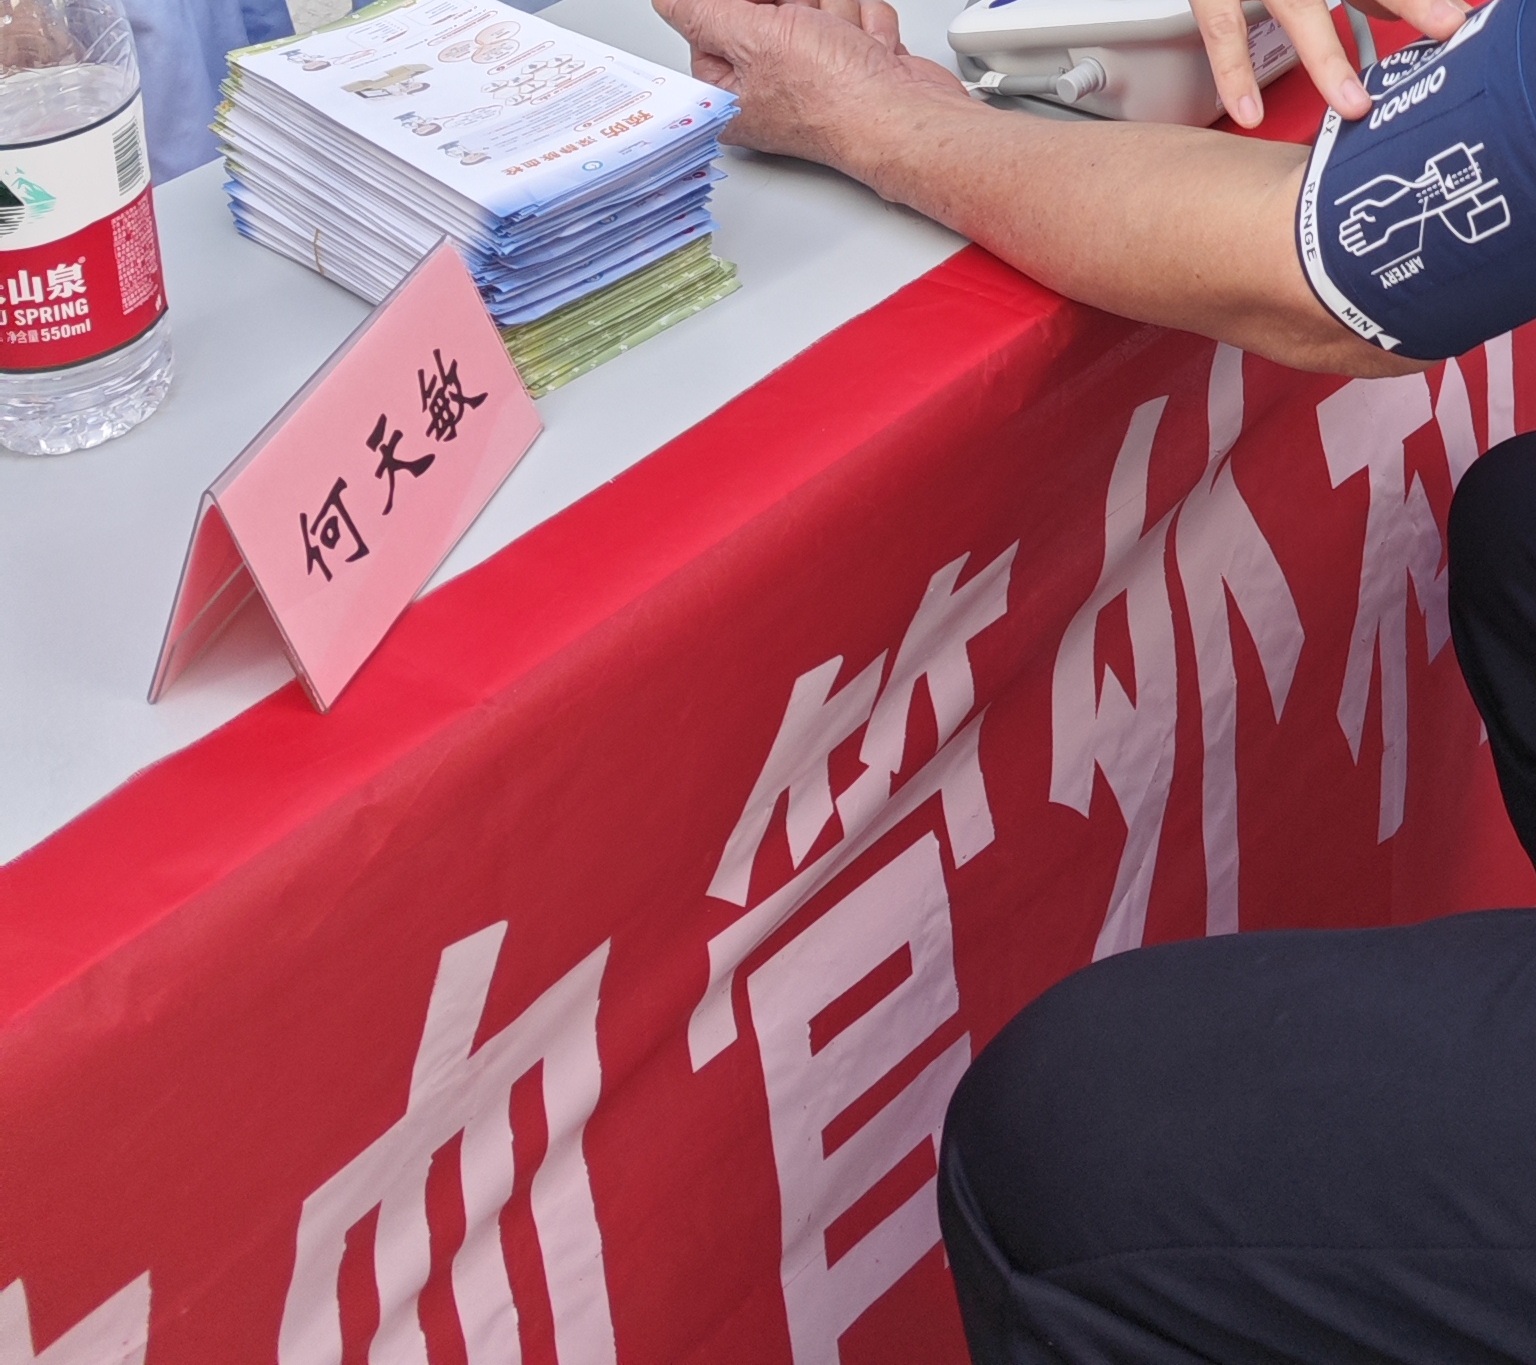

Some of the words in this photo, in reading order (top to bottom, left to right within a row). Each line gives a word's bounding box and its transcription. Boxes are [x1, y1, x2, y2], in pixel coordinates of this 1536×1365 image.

[1301, 181, 1319, 262] RANGE
[0, 263, 87, 305] 山泉
[1379, 255, 1425, 289] ARTERY
[14, 298, 90, 326] SPRING
[1341, 306, 1374, 332] MIN
